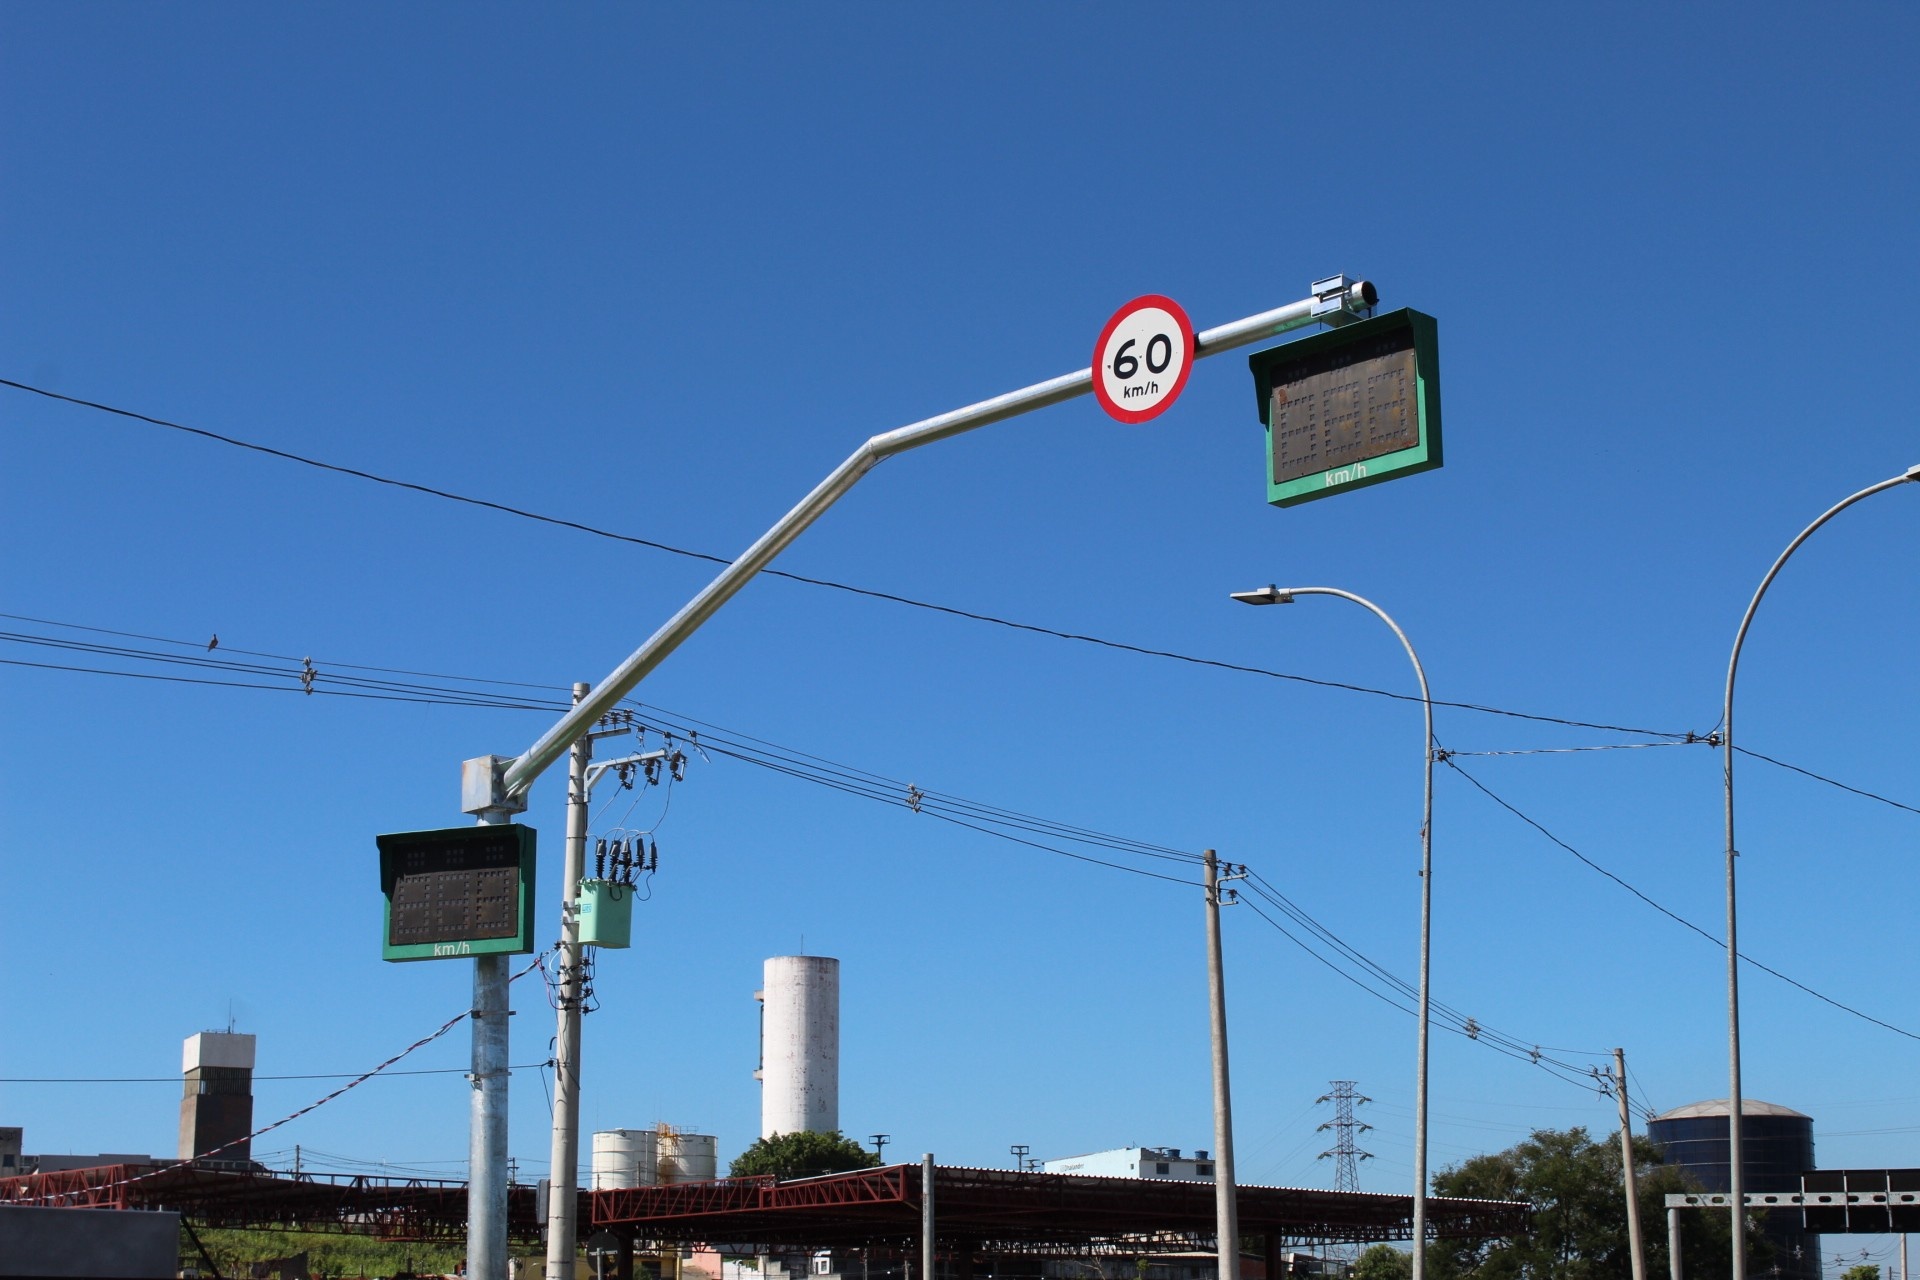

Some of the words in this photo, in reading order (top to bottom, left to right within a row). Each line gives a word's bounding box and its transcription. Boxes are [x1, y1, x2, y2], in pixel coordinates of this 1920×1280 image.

[1113, 333, 1172, 379] 60
[1123, 381, 1159, 399] km/h
[1325, 463, 1367, 487] km/h
[434, 942, 471, 957] km/h
